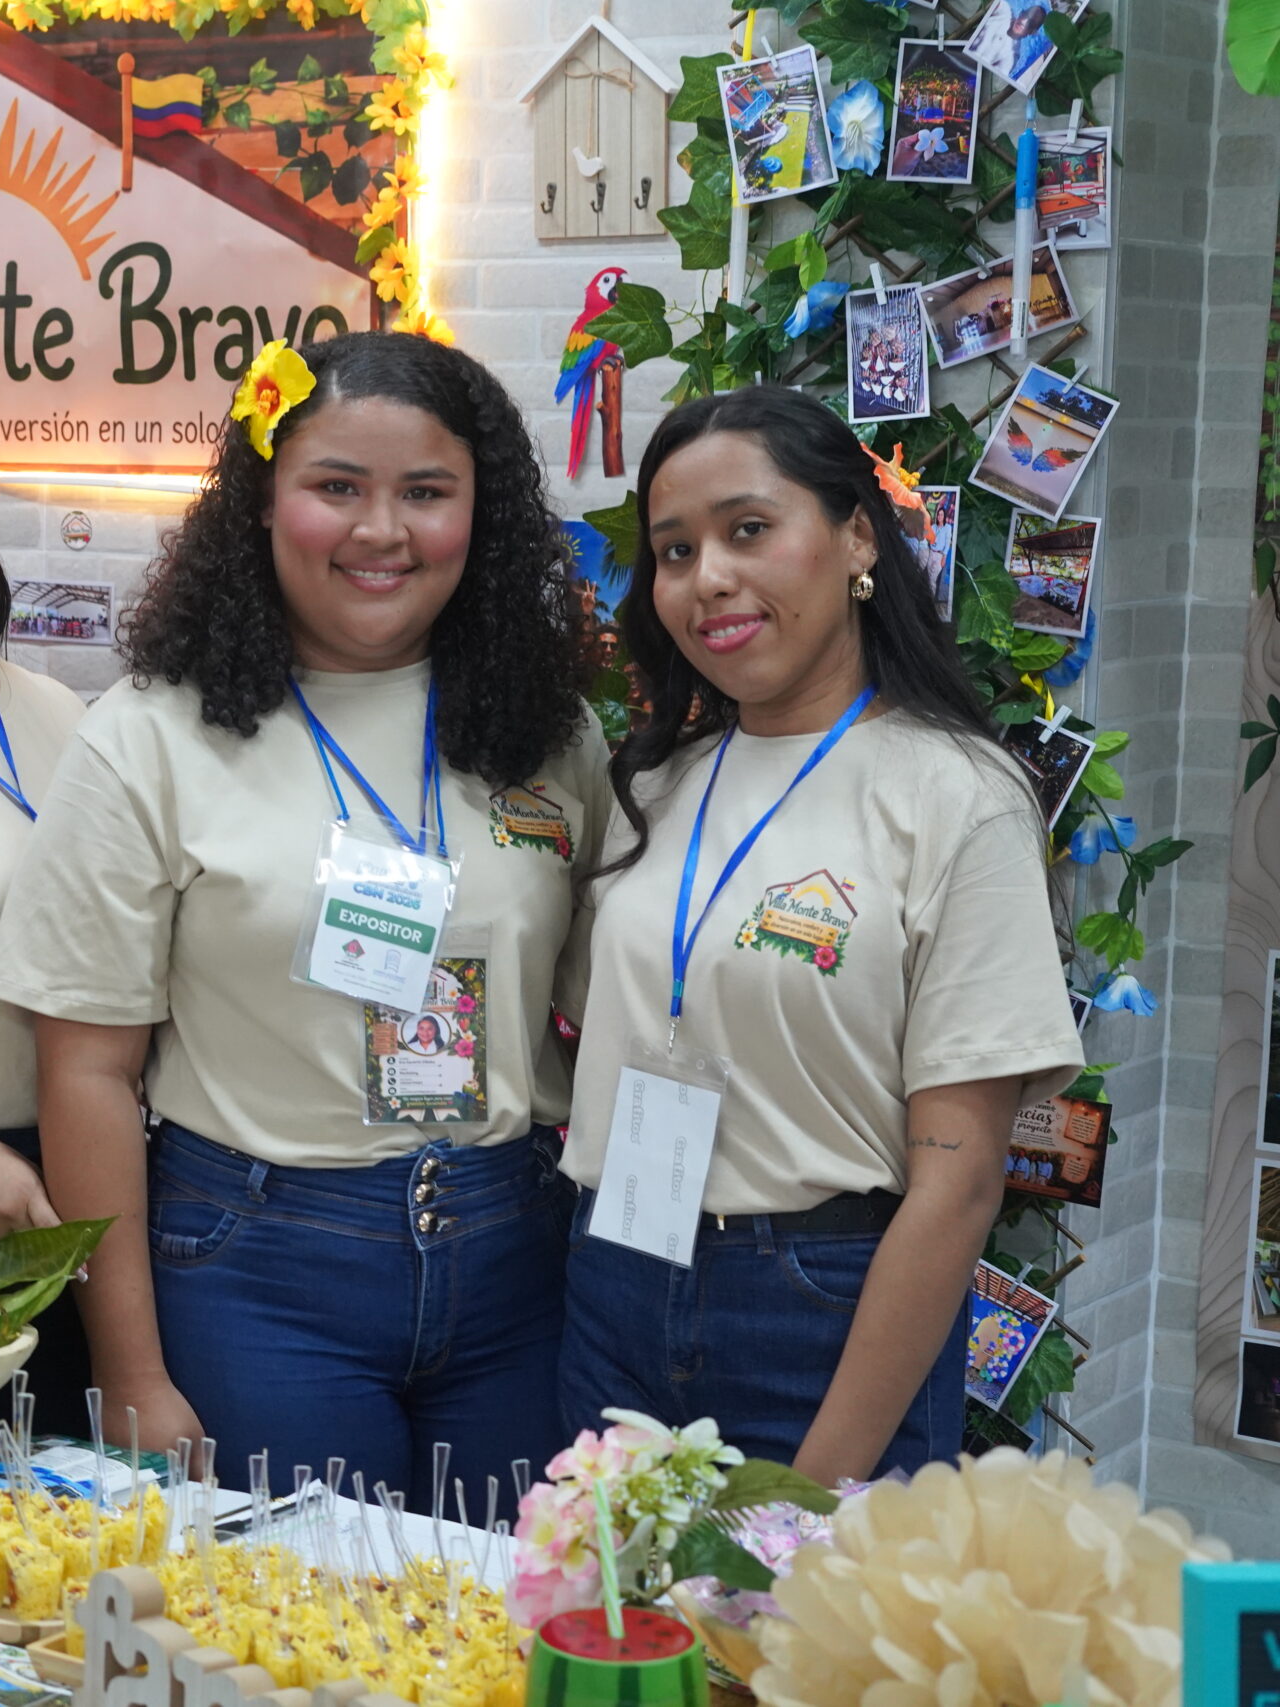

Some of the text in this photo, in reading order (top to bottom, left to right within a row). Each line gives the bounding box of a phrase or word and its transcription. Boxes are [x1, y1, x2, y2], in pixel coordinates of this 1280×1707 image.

[99, 420, 125, 443] en
[135, 420, 162, 444] un
[172, 417, 219, 444] solo
[493, 800, 563, 820] Villa Monte Bravo
[353, 882, 384, 900] CBN
[386, 892, 421, 910] 2026
[767, 891, 849, 930] Villa Monte Bravo
[339, 908, 422, 944] EXPOSITOR
[1015, 1109, 1052, 1126] acias
[1017, 1122, 1051, 1134] proyecto
